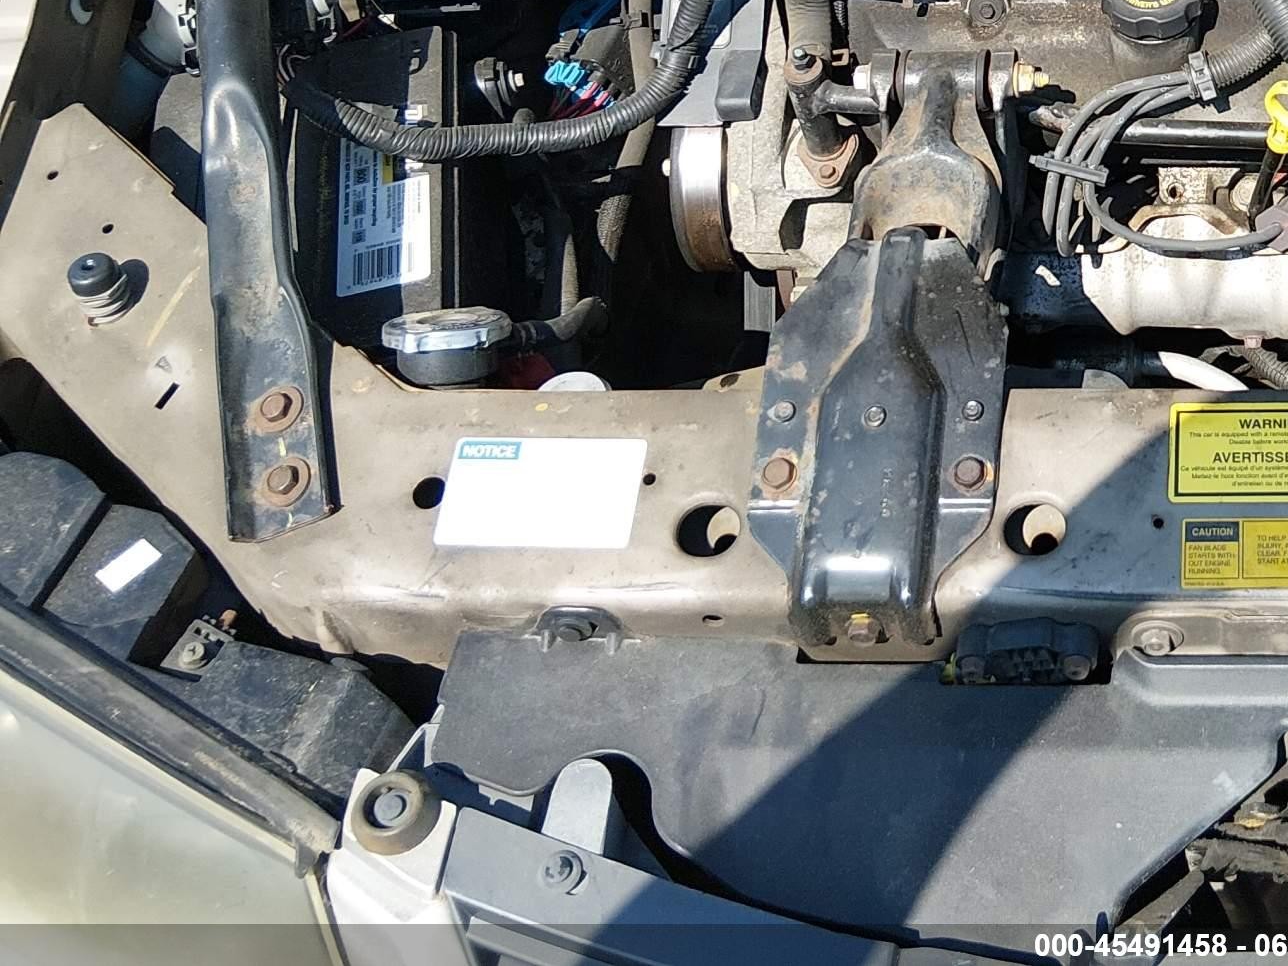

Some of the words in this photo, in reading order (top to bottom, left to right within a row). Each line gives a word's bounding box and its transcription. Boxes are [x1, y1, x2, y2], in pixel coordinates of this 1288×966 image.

[1221, 431, 1249, 439] equipped
[463, 444, 517, 459] NOTICE
[1228, 464, 1249, 472] équipé
[1192, 527, 1234, 536] CAUTION
